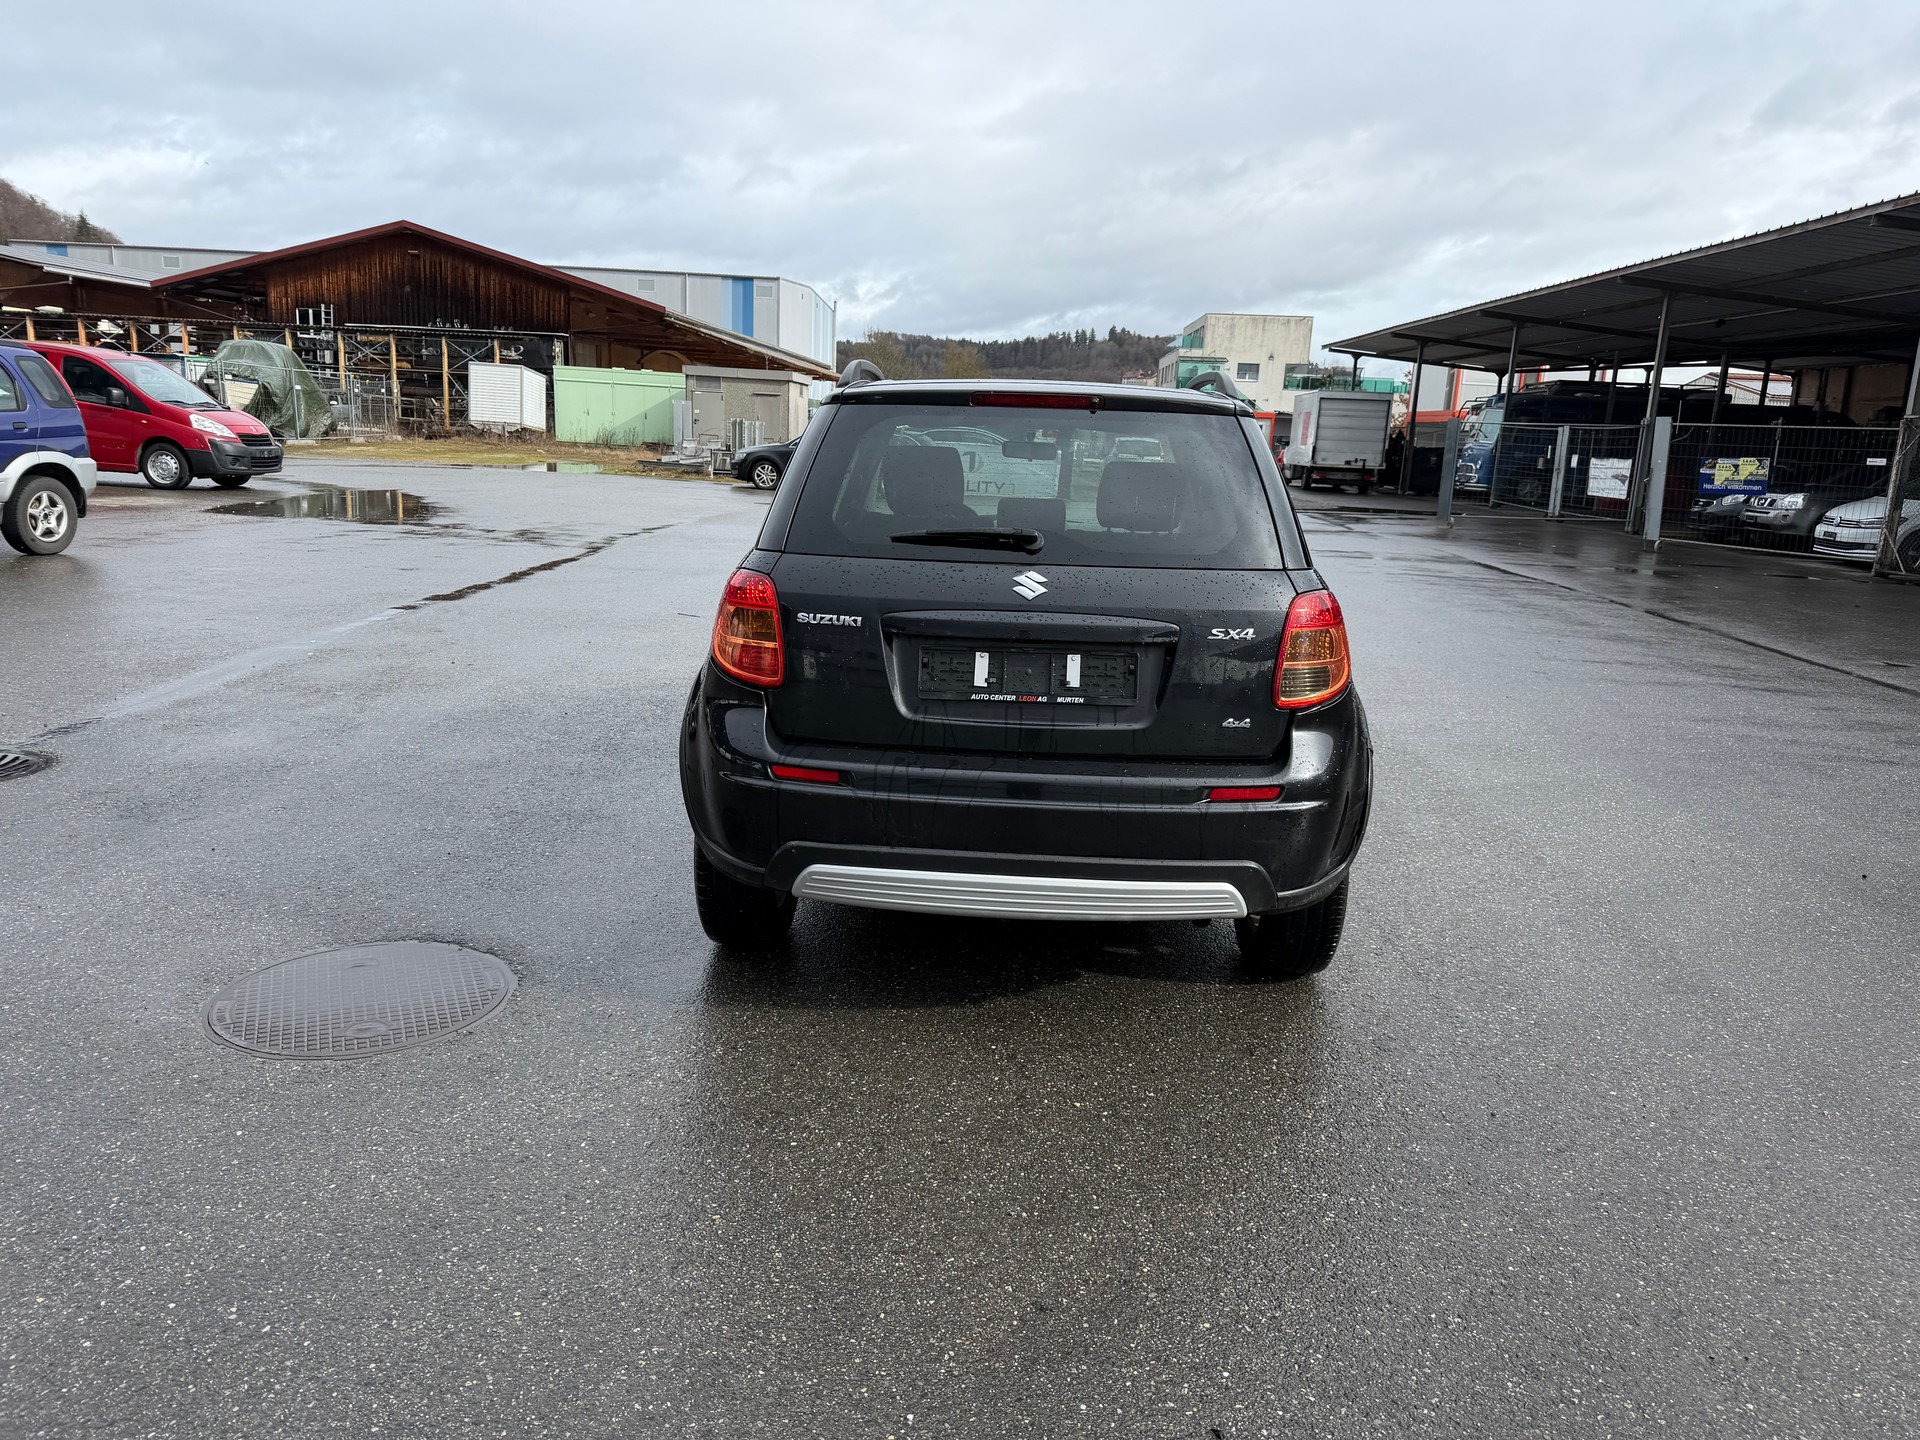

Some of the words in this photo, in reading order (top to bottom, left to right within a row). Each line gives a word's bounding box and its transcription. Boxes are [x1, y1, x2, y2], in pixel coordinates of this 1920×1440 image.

[1727, 483, 1762, 491] willkommen
[796, 612, 862, 627] SUZUKI
[1207, 628, 1256, 640] SX4
